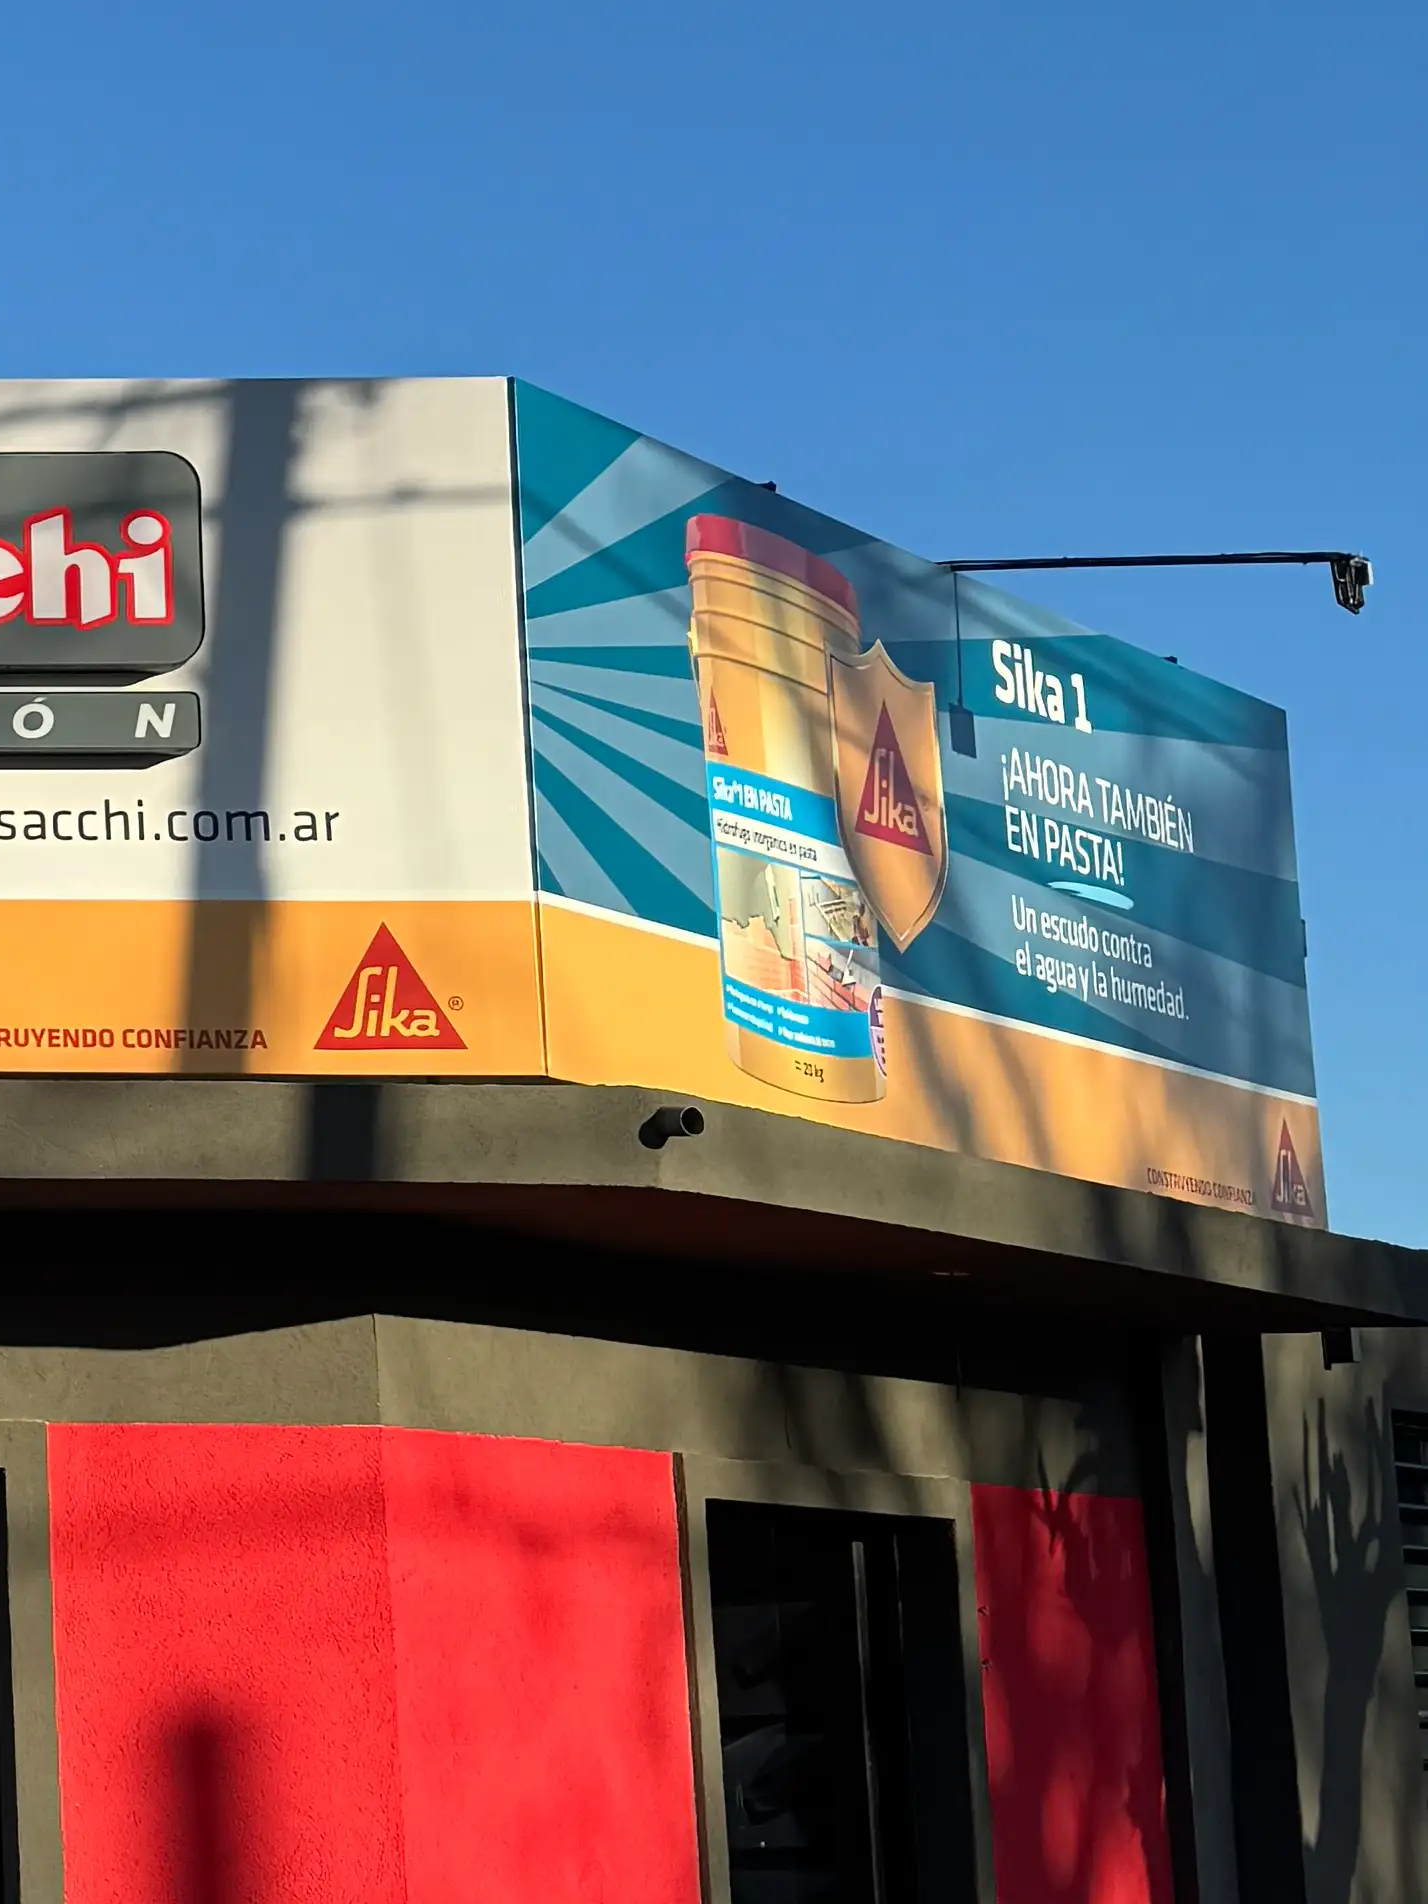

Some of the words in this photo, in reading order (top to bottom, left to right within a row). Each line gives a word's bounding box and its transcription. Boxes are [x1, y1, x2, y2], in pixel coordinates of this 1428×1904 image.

[991, 640, 1064, 725] Sika
[1071, 674, 1093, 734] 1
[866, 747, 919, 837] Sika
[1001, 746, 1094, 820] ¡AHORA
[1096, 777, 1195, 853] TAMBIÉN
[1005, 807, 1041, 861] EN
[1046, 822, 1125, 887] PASTA!
[1012, 895, 1037, 932] Un
[1040, 910, 1099, 955] escudo
[1101, 927, 1153, 969] contra
[332, 965, 441, 1041] Sika
[1015, 945, 1034, 977] el
[1035, 960, 1078, 998] agua
[1079, 969, 1089, 1000] y
[1092, 964, 1107, 998] la
[1110, 972, 1189, 1022] humedad.
[120, 1027, 268, 1050] CONFIANZA
[1147, 1167, 1213, 1201] CONSTRUYENDO
[1273, 1148, 1307, 1208] Sika
